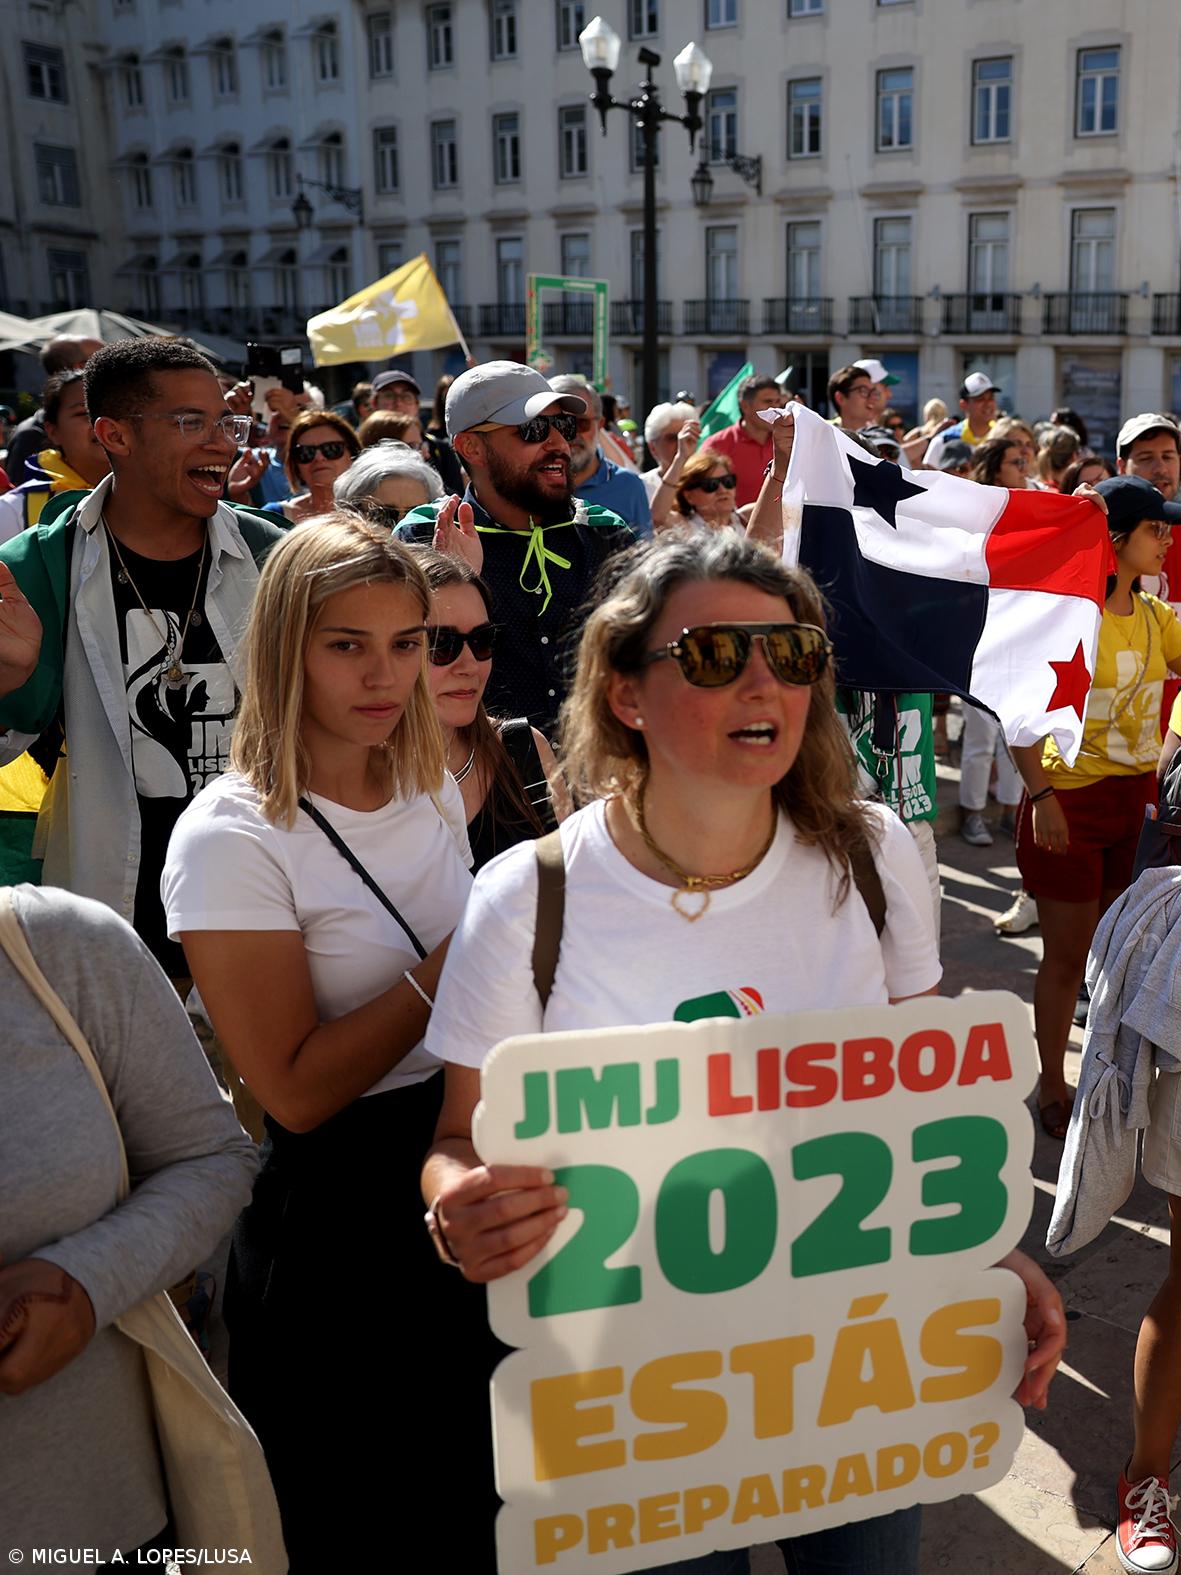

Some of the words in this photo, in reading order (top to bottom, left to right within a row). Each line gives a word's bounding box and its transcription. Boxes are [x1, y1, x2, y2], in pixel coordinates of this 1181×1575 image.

[187, 720, 237, 757] JM
[187, 757, 231, 773] LISB
[515, 1058, 680, 1140] JMJ
[708, 1023, 1012, 1117] LISBOA
[528, 1115, 1008, 1319] 2023
[530, 1293, 1003, 1482] ESTÁS
[534, 1422, 1000, 1565] PREPARADO?
